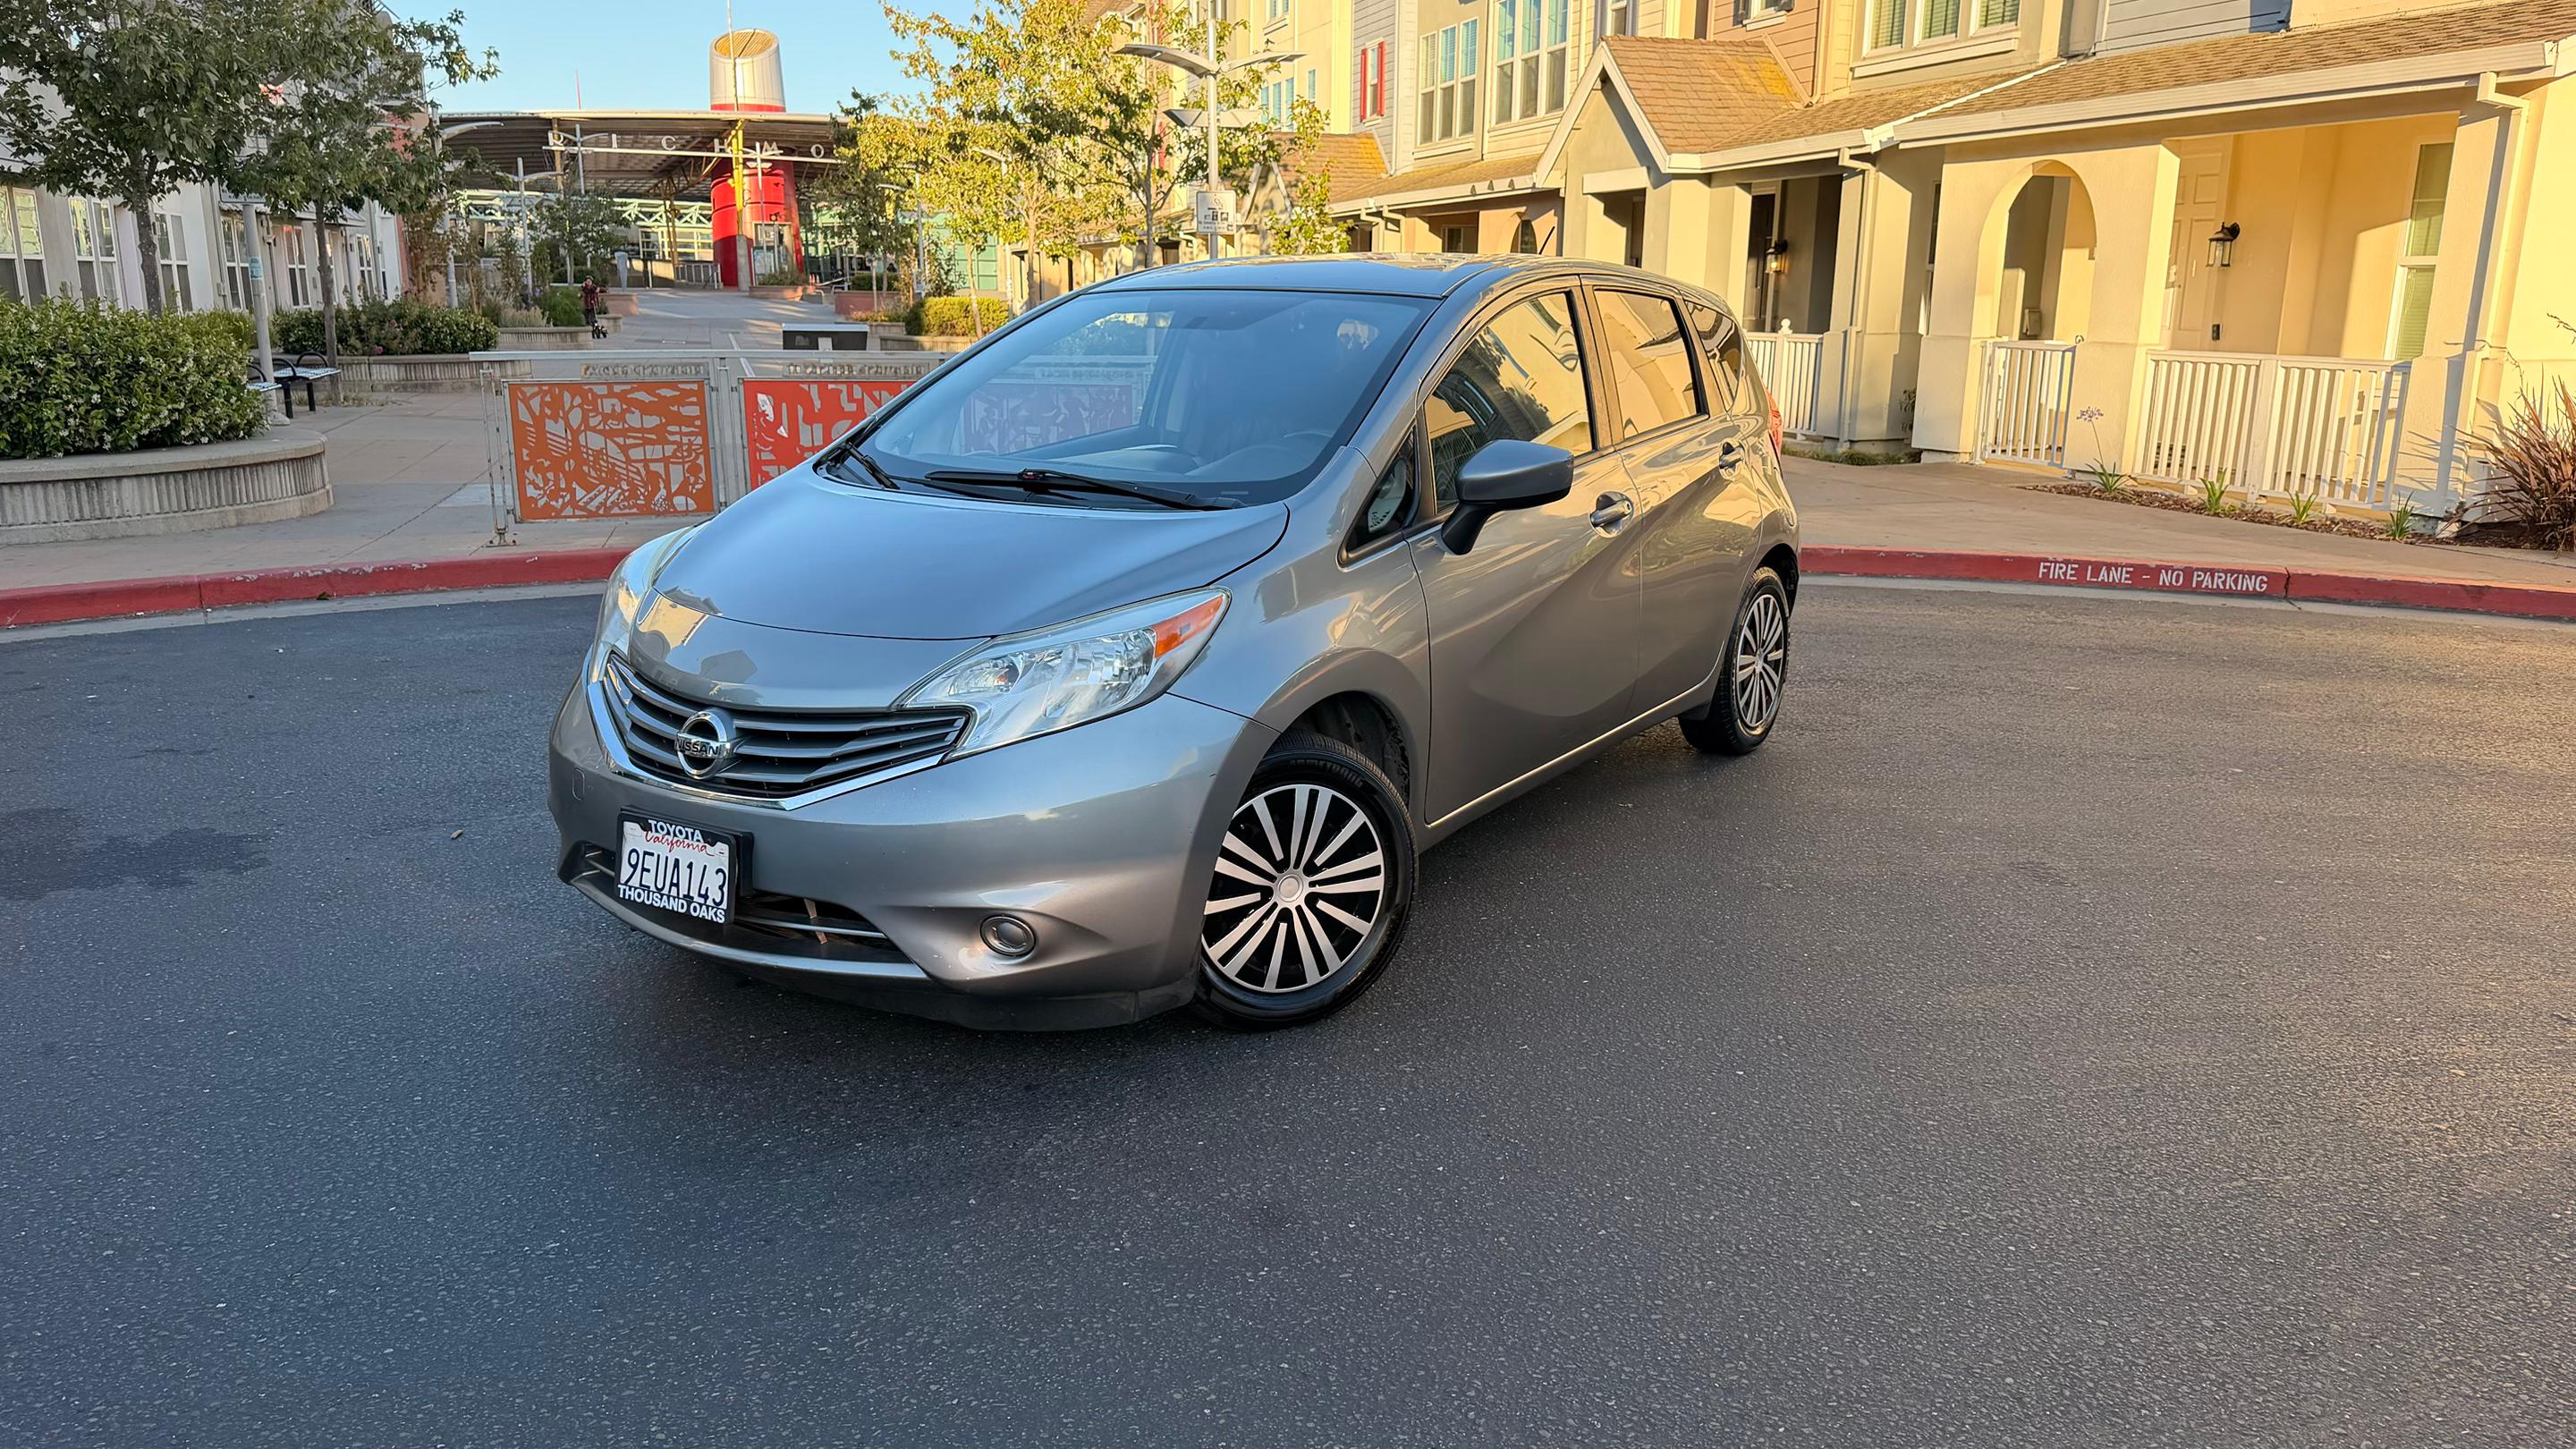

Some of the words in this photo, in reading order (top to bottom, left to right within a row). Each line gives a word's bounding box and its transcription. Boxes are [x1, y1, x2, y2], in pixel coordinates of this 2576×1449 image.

[547, 131, 825, 159] RICHMO
[2038, 562, 2079, 581] FIRE
[2087, 565, 2133, 584] LANE
[2159, 569, 2184, 587] NO
[2192, 571, 2268, 592] PARKING
[674, 736, 721, 757] NISSAN
[644, 830, 715, 857] California
[648, 819, 705, 843] TOYOTA
[624, 848, 727, 907] 9EUA143
[617, 884, 688, 913] THOUSAND
[691, 902, 725, 924] OAKS
